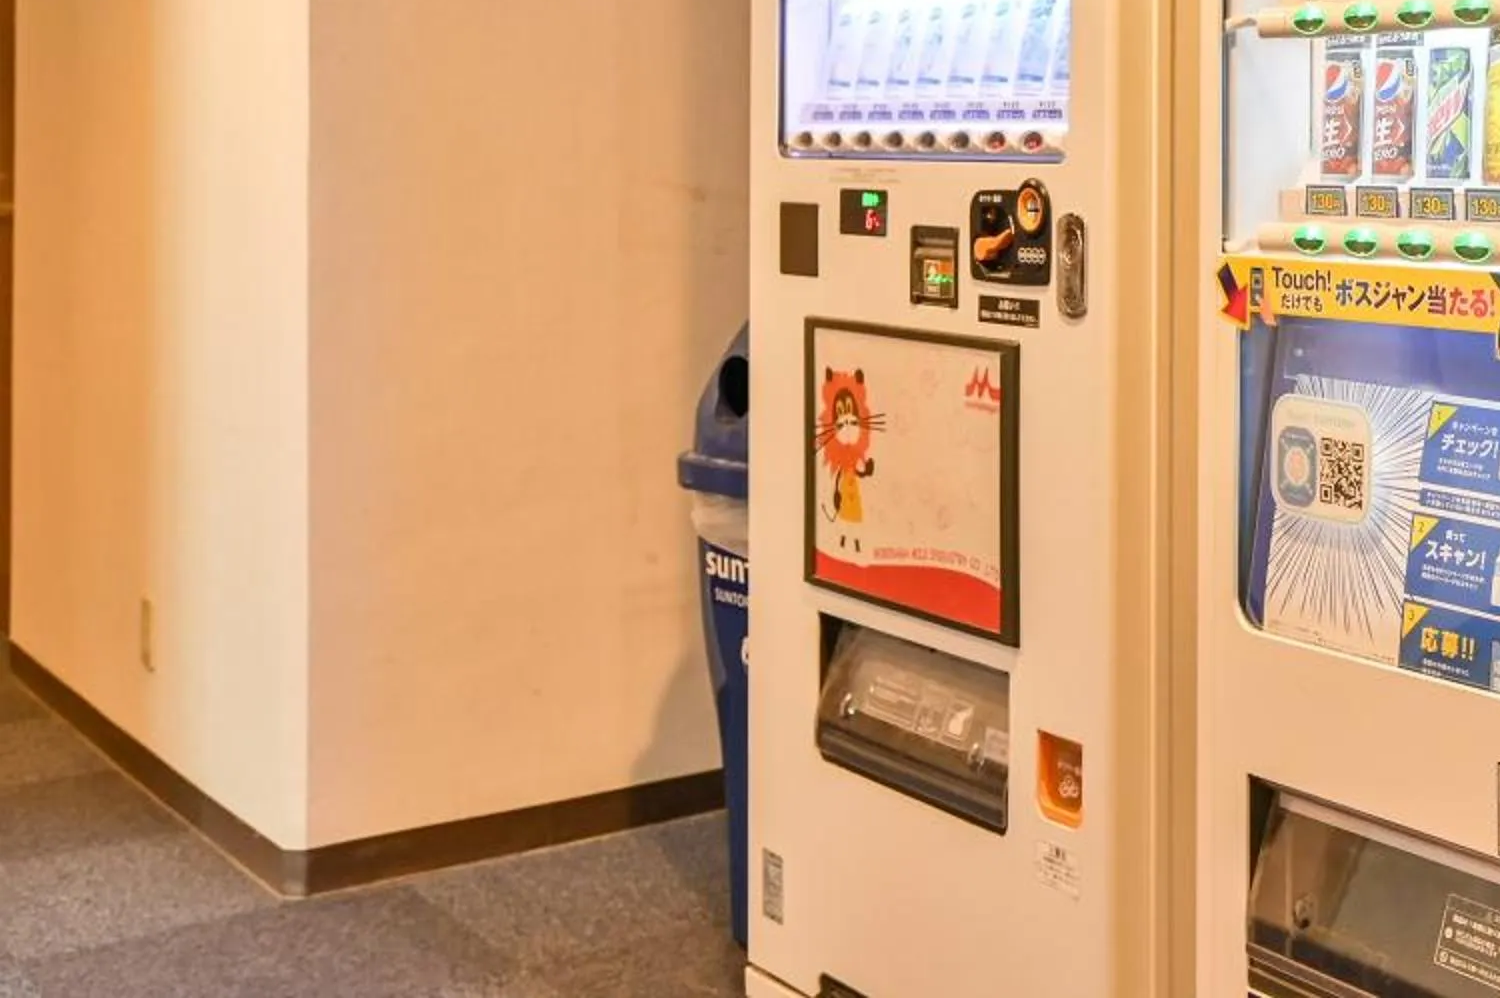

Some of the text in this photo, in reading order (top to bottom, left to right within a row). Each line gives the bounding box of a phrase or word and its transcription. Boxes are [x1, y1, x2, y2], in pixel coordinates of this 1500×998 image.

[1271, 265, 1332, 291] Touch!
[1279, 292, 1324, 312] だけでも
[1334, 277, 1496, 319] ボスジャン当たる!
[1440, 432, 1500, 459] チェック!
[1425, 541, 1487, 571] スキャン!
